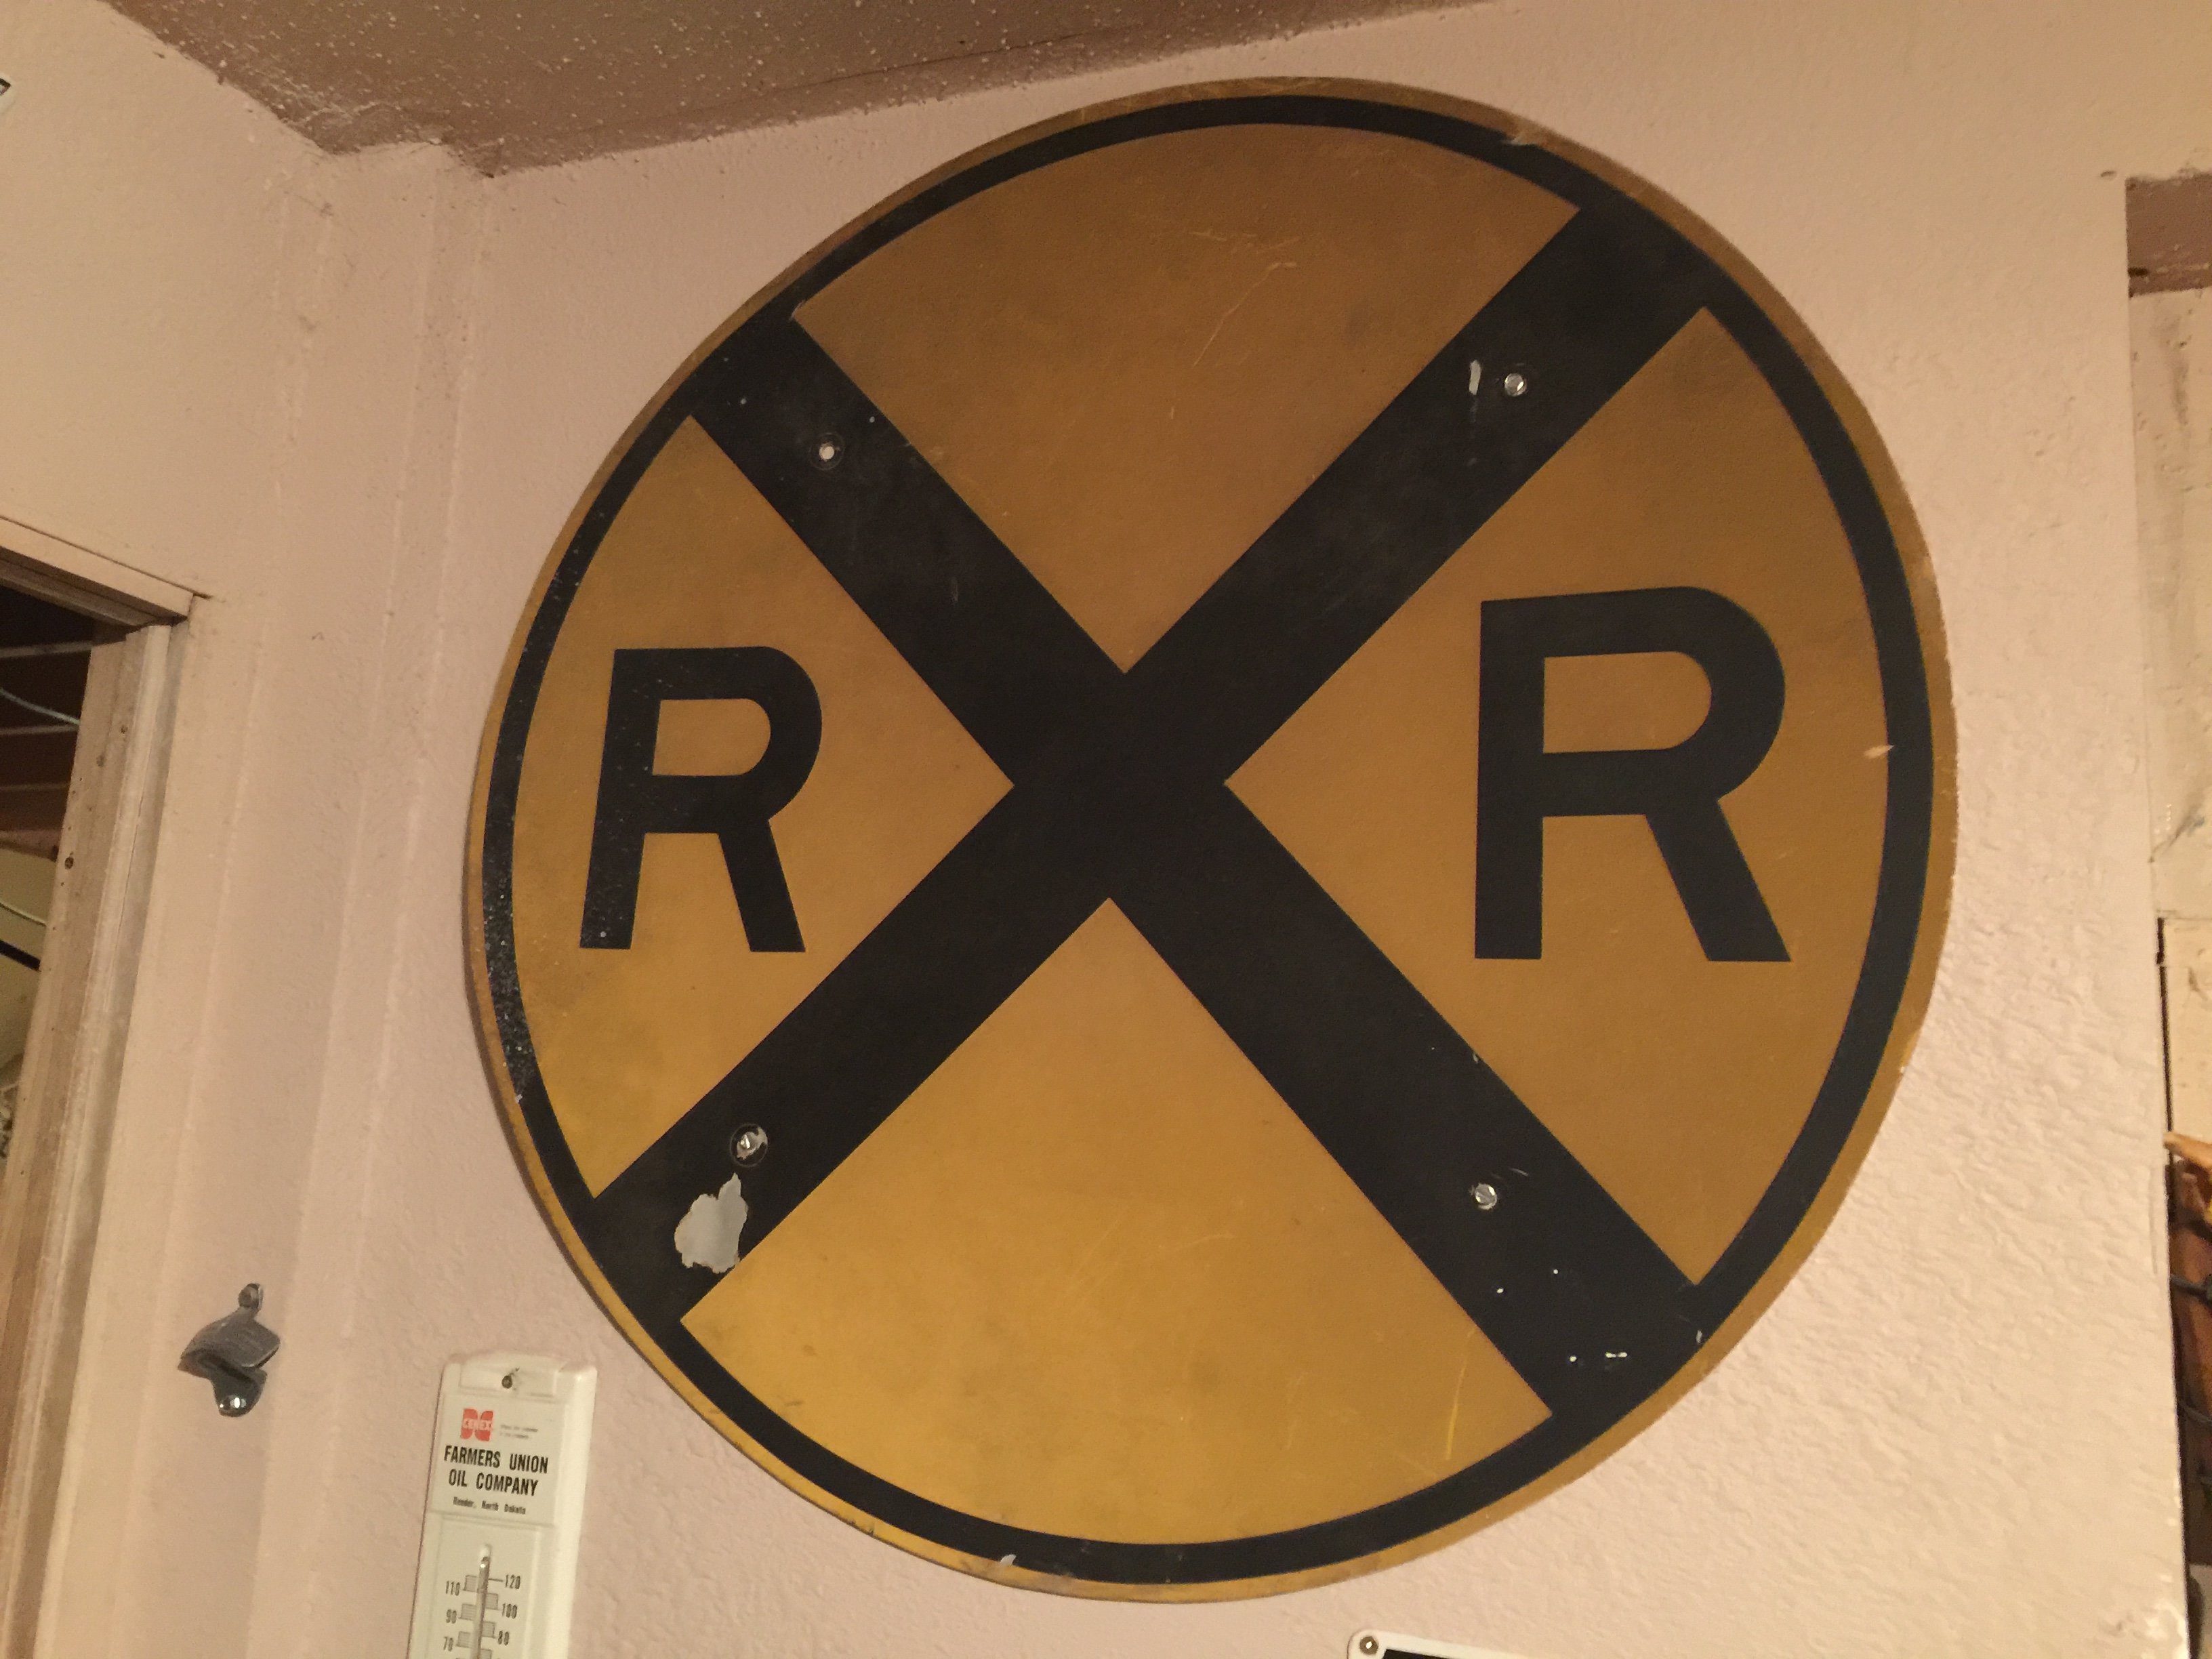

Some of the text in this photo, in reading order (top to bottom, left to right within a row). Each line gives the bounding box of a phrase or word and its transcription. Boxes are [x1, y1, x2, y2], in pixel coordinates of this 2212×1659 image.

[580, 646, 823, 952] R
[1474, 586, 1790, 962] R
[444, 1445, 548, 1474] FARMERS UNION
[449, 1469, 539, 1496] OIL COMPANY
[481, 1500, 499, 1511] North
[504, 1503, 526, 1515] Dakota
[445, 1580, 461, 1596] 110
[505, 1574, 521, 1590] 120
[445, 1609, 457, 1624] 90
[501, 1603, 518, 1619] 100
[443, 1636, 454, 1652] 70
[497, 1631, 510, 1646] 80
